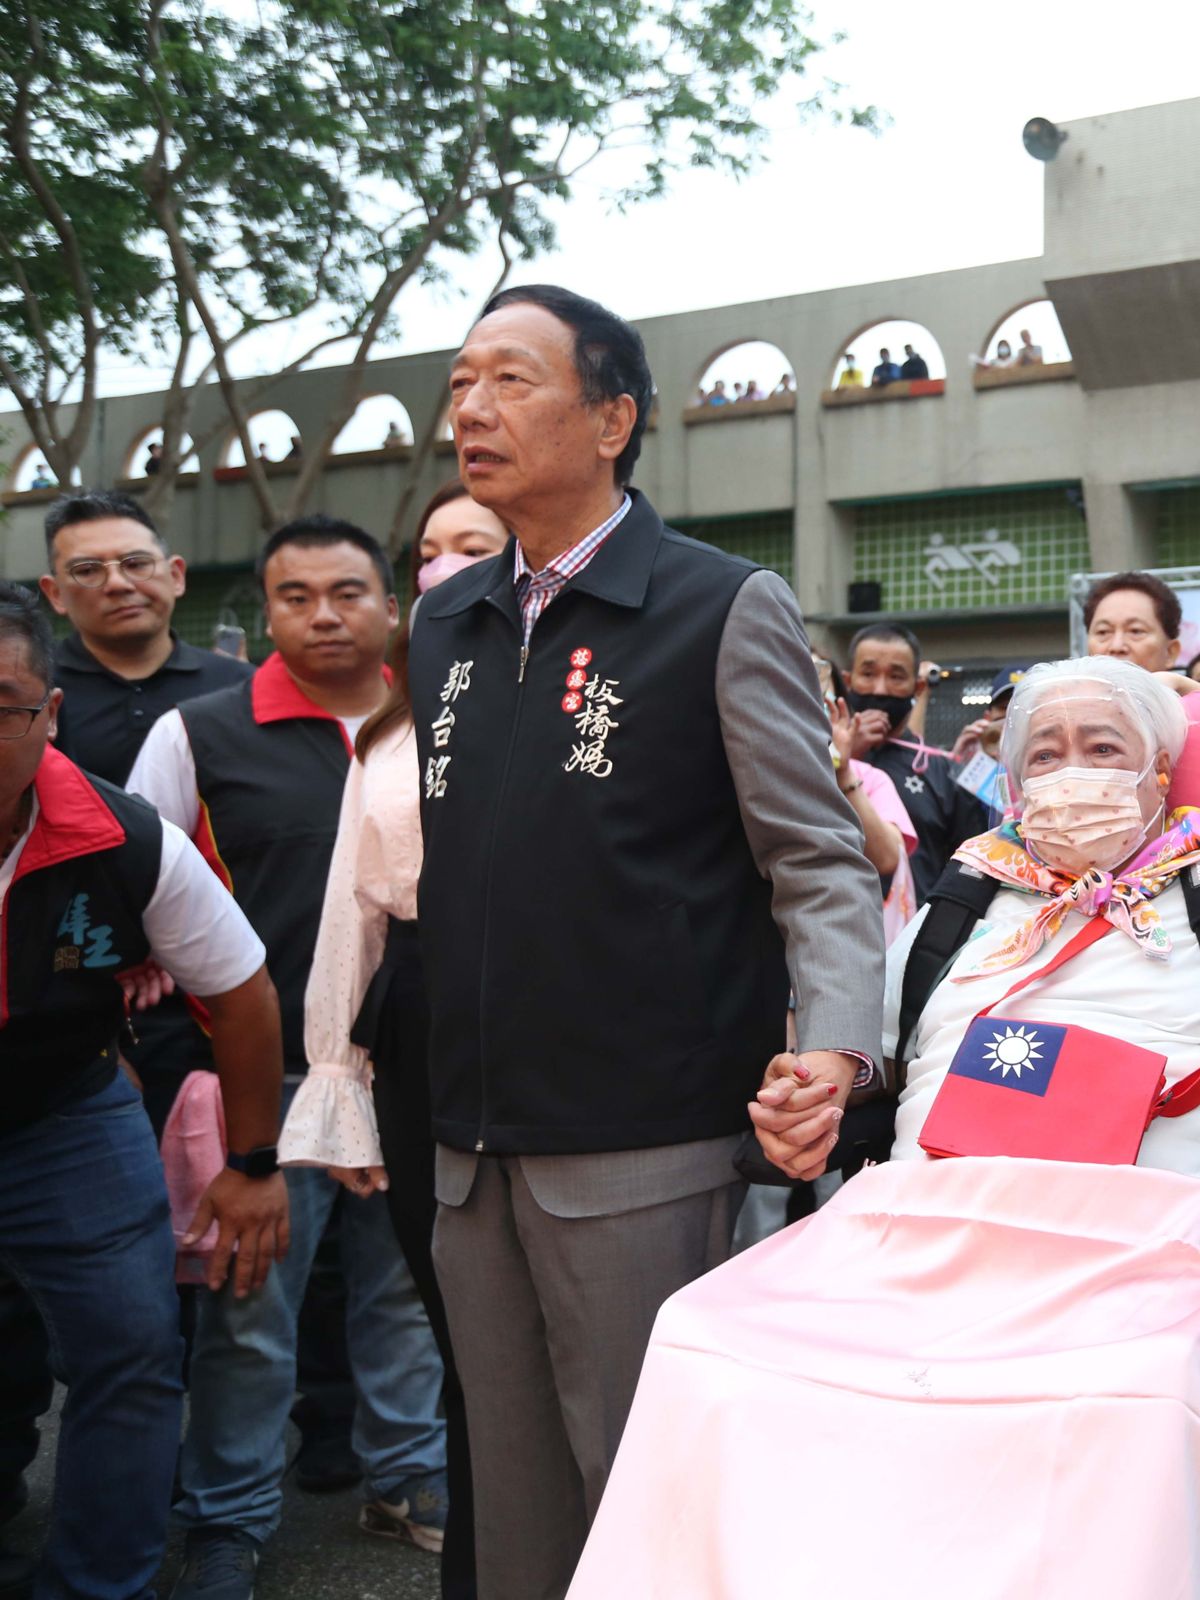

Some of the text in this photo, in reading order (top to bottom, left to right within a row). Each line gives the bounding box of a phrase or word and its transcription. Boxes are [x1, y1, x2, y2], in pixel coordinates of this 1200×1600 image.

[424, 660, 474, 799] 郭台銘
[562, 673, 625, 778] 板橋媽
